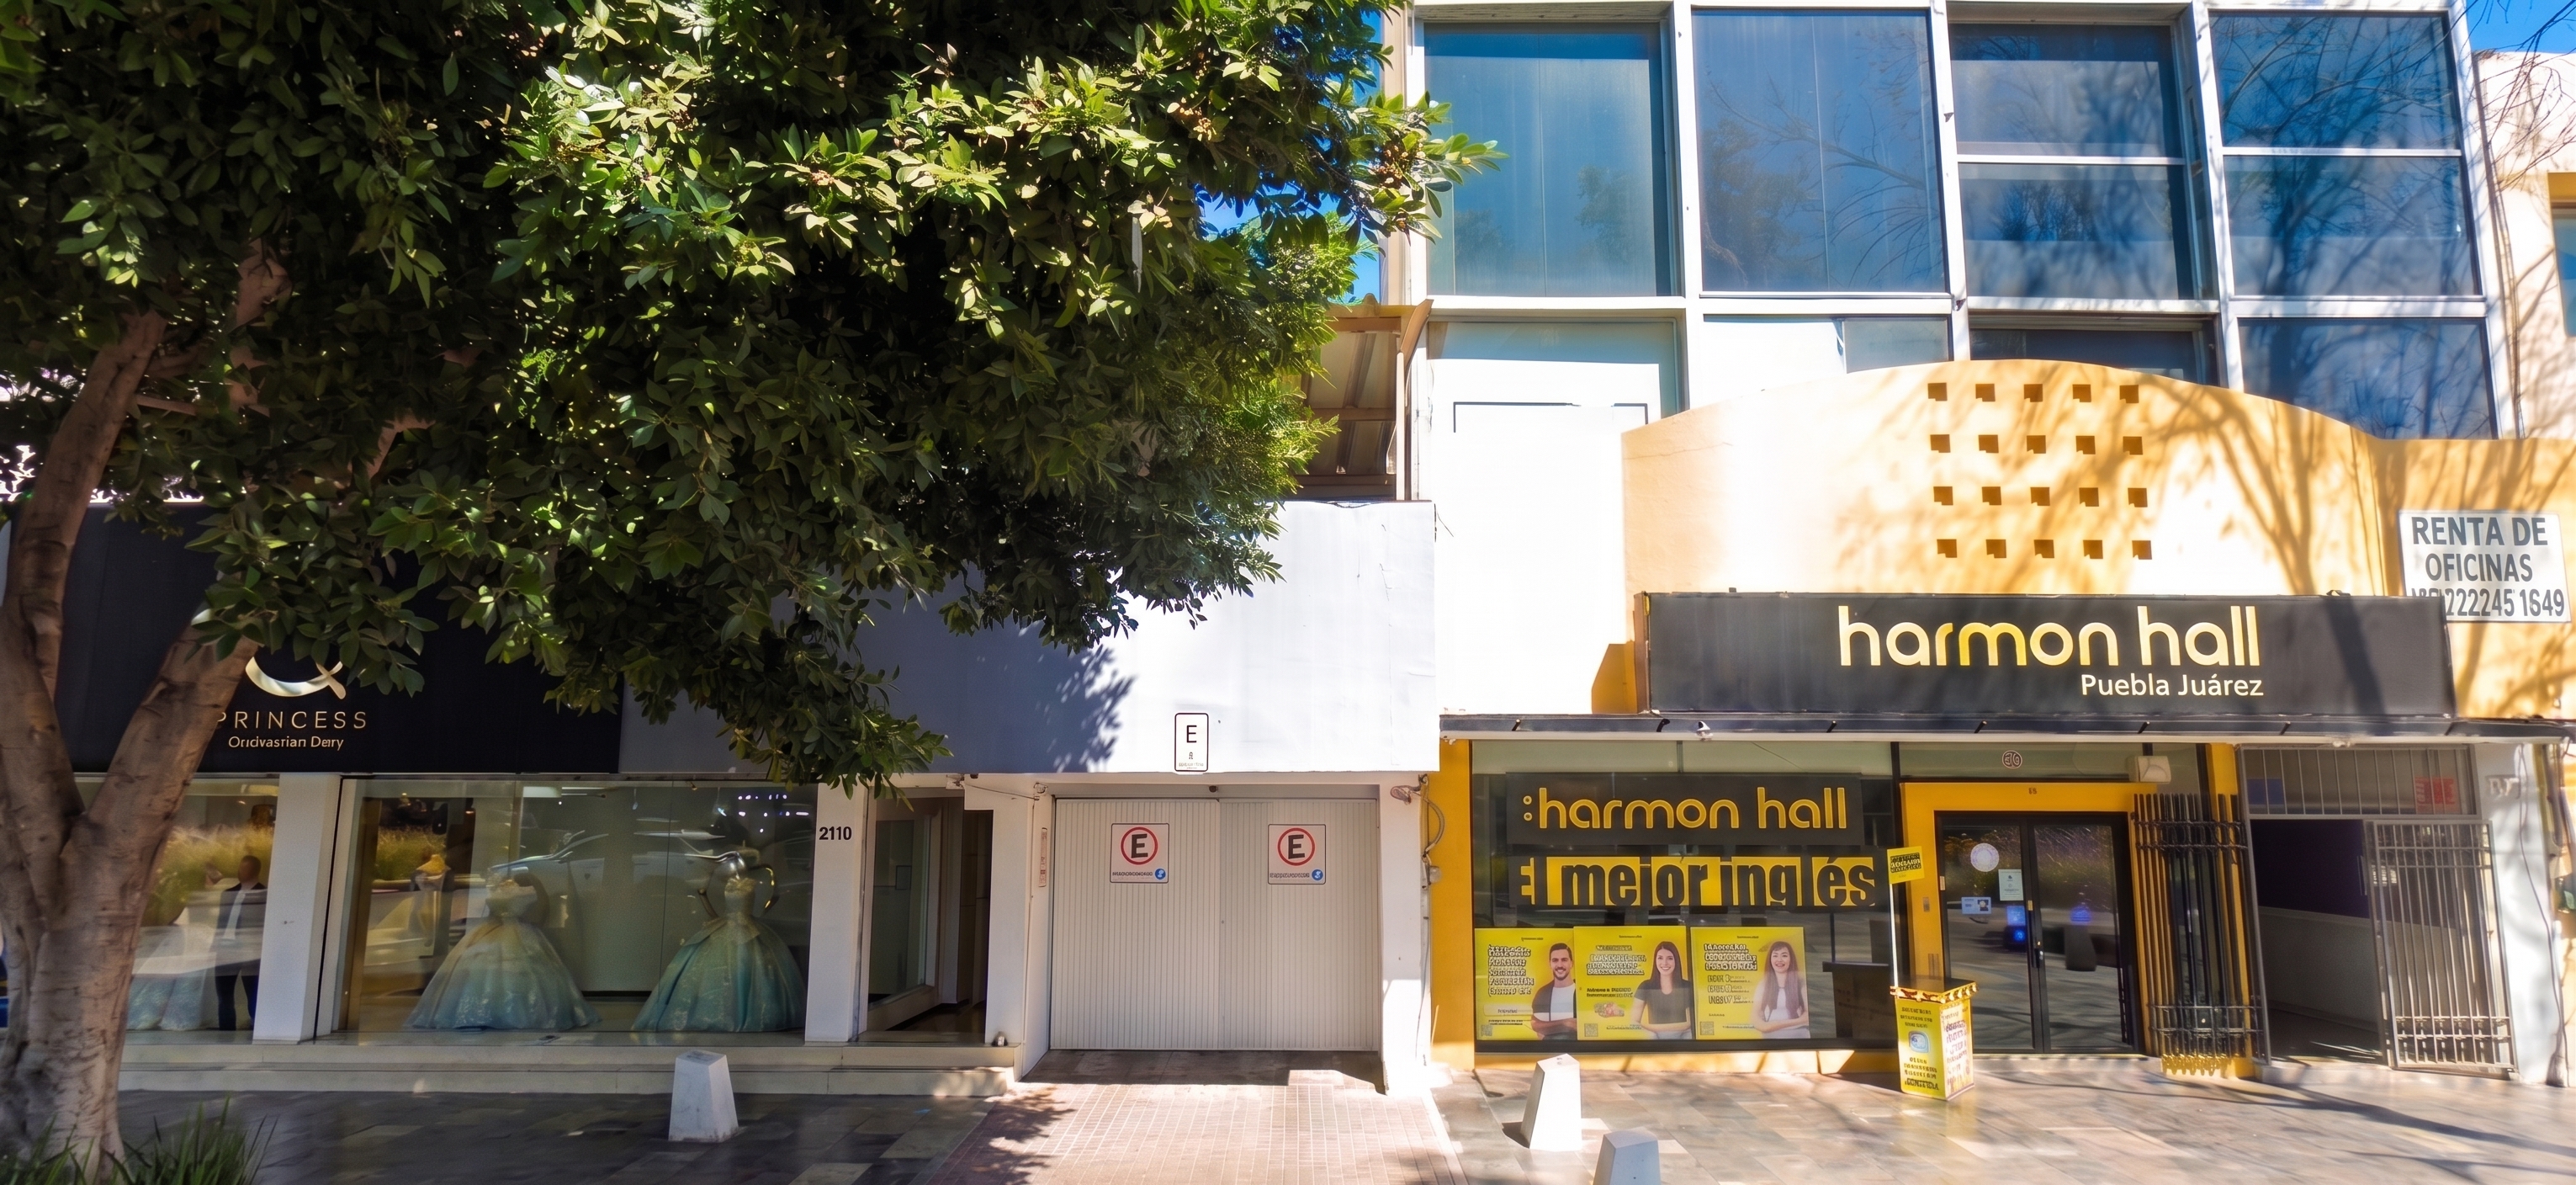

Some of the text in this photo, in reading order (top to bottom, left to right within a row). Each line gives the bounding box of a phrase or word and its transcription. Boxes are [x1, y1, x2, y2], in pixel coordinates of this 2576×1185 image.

[2411, 517, 2548, 545] RENTA DE
[2425, 553, 2533, 582] OFICINAS
[2520, 588, 2564, 617] 1649
[1838, 605, 2261, 667] harmon hall
[2081, 673, 2264, 696] Puebla Juárez
[1186, 725, 1197, 743] E
[1757, 787, 1847, 829] hall
[819, 826, 852, 840] 2110
[1131, 833, 1148, 858] E
[1288, 834, 1306, 859] E
[1561, 857, 1709, 906] mejor
